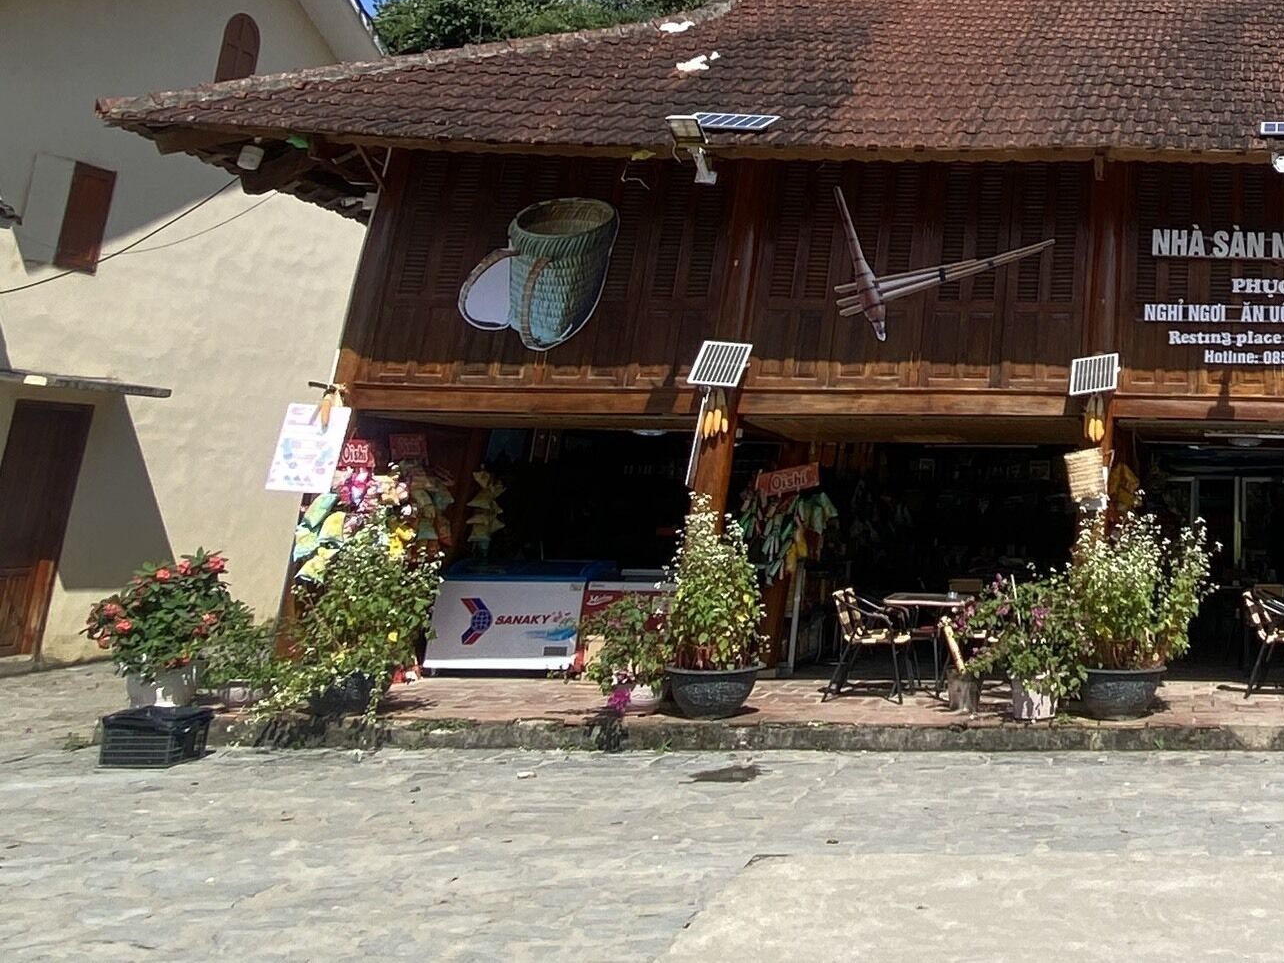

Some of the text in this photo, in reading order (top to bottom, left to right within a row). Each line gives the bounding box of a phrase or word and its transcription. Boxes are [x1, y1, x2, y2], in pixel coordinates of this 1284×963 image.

[1151, 224, 1206, 257] NHÀ
[1212, 224, 1266, 258] SÀN
[1143, 298, 1184, 322] NGHỈ
[1187, 303, 1227, 323] NGƠI
[1240, 301, 1266, 323] ĂN
[1168, 330, 1232, 346] Resting
[1235, 330, 1282, 347] place
[1203, 349, 1260, 365] Hotline:
[342, 443, 369, 464] Oishi
[770, 470, 808, 492] Oishi
[494, 613, 551, 626] SANAKY
